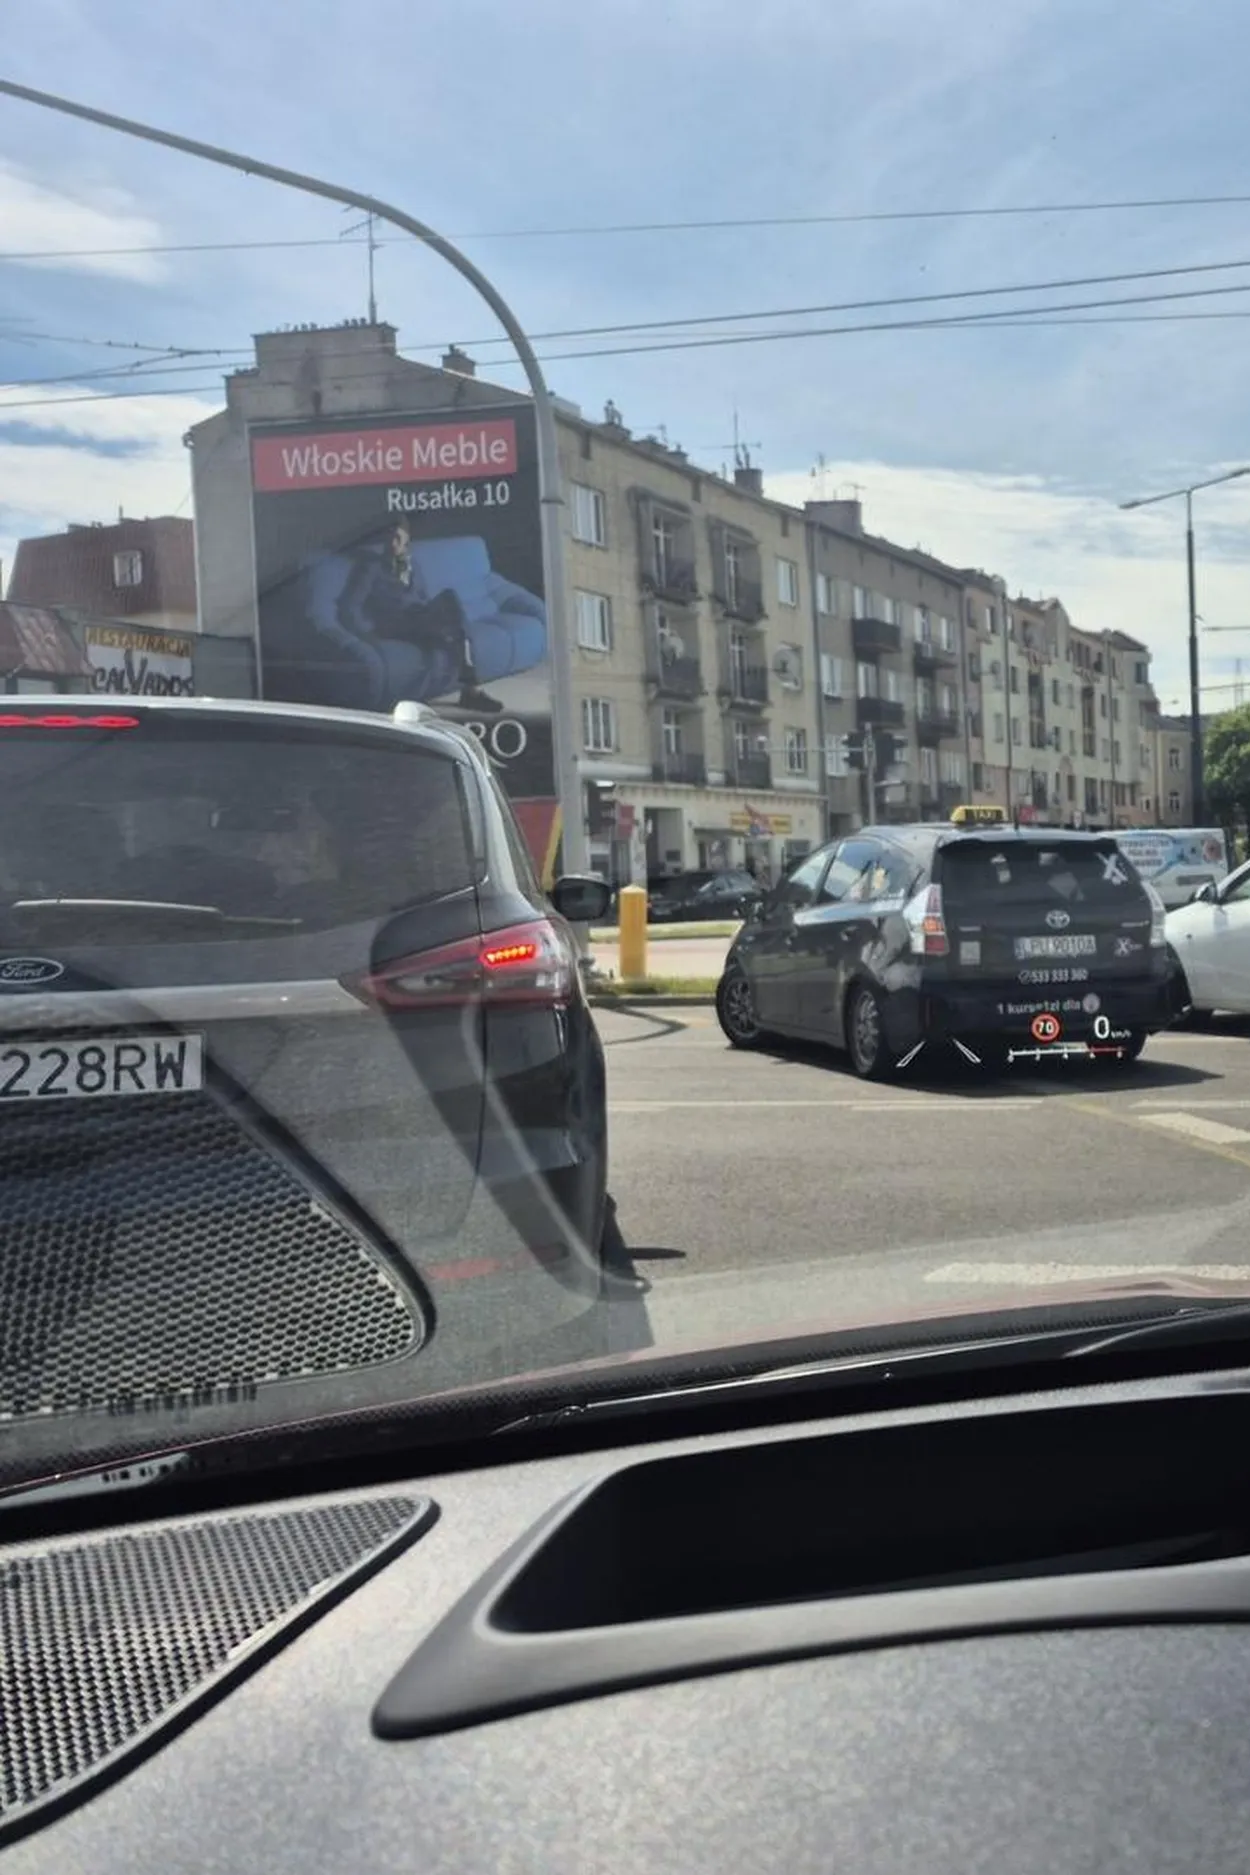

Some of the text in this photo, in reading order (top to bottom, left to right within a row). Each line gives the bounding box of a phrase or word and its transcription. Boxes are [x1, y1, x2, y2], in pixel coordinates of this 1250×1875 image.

[281, 431, 508, 478] Włoskie Meble
[387, 481, 510, 512] Rusałka 10
[1, 962, 45, 978] Ford
[1037, 1021, 1055, 1035] 70
[1093, 1015, 1110, 1039] 0
[0, 1041, 187, 1098] 228RW
